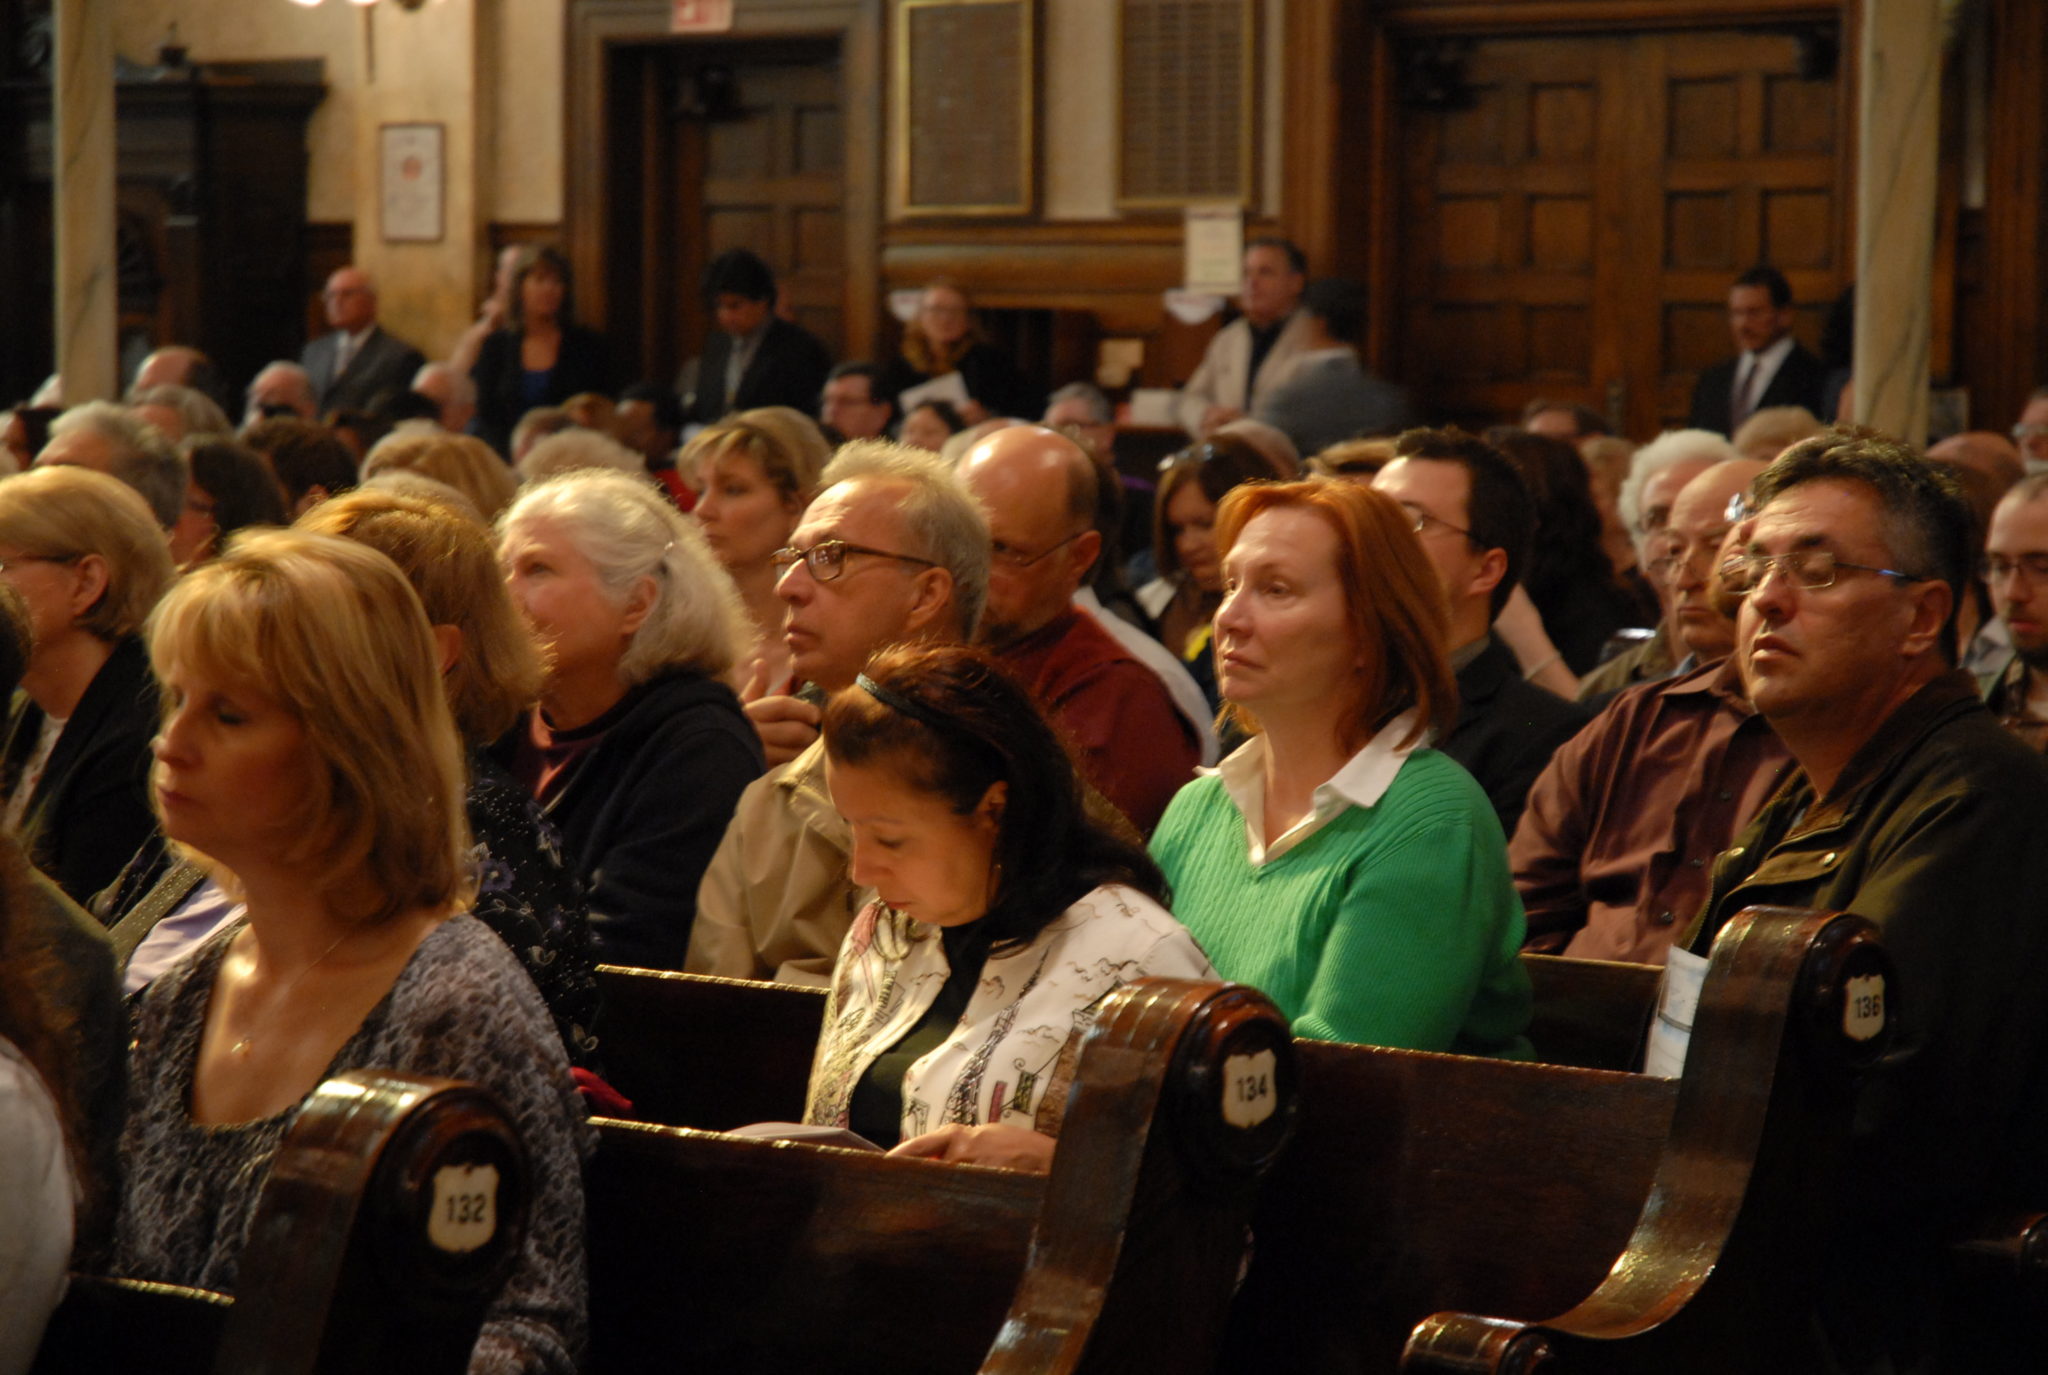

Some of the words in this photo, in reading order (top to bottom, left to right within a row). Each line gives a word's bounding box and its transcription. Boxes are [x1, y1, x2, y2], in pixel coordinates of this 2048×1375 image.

[1855, 994, 1881, 1019] 136
[1237, 1073, 1267, 1102] 134
[447, 1193, 486, 1225] 132
